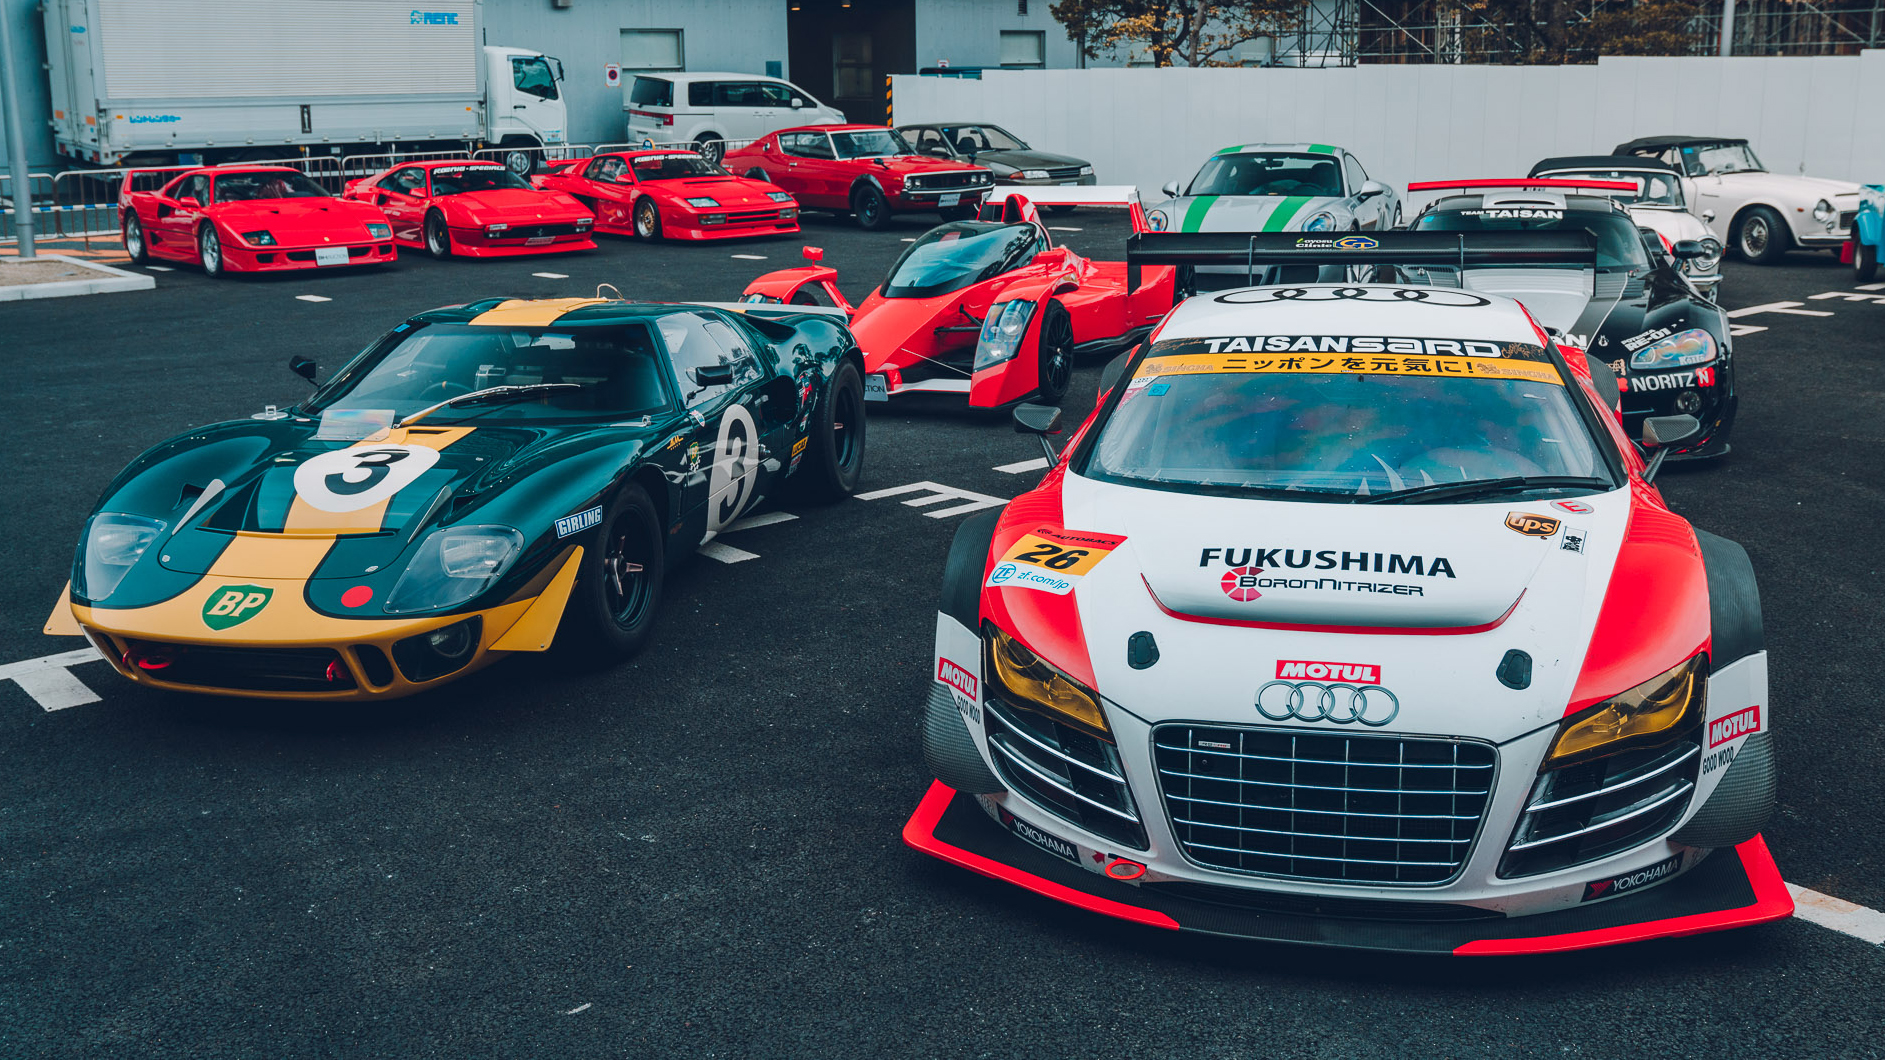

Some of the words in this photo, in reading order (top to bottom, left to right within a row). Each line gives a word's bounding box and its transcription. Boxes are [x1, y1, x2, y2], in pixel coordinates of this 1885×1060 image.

[1486, 209, 1564, 219] TAISAN
[1203, 336, 1350, 354] TAISAN
[1624, 327, 1672, 351] RE-01
[1631, 372, 1696, 392] NORITZ
[324, 449, 410, 496] 3
[558, 508, 601, 536] GIRLING
[1509, 516, 1555, 533] ups
[1049, 533, 1119, 546] AUTOBACS
[1013, 543, 1090, 570] 26
[1199, 548, 1457, 579] FUKUSHIMA
[1017, 571, 1070, 590] zf.com/jp
[205, 591, 267, 618] BP
[940, 661, 976, 698] MOTUL
[1280, 662, 1377, 682] MOTUL
[1711, 710, 1758, 745] MOTUL
[1702, 753, 1718, 776] GOOD
[1718, 746, 1734, 768] WOOD
[1013, 818, 1076, 859] YOKOHAMA
[1613, 858, 1679, 893] YOKOHAMA
